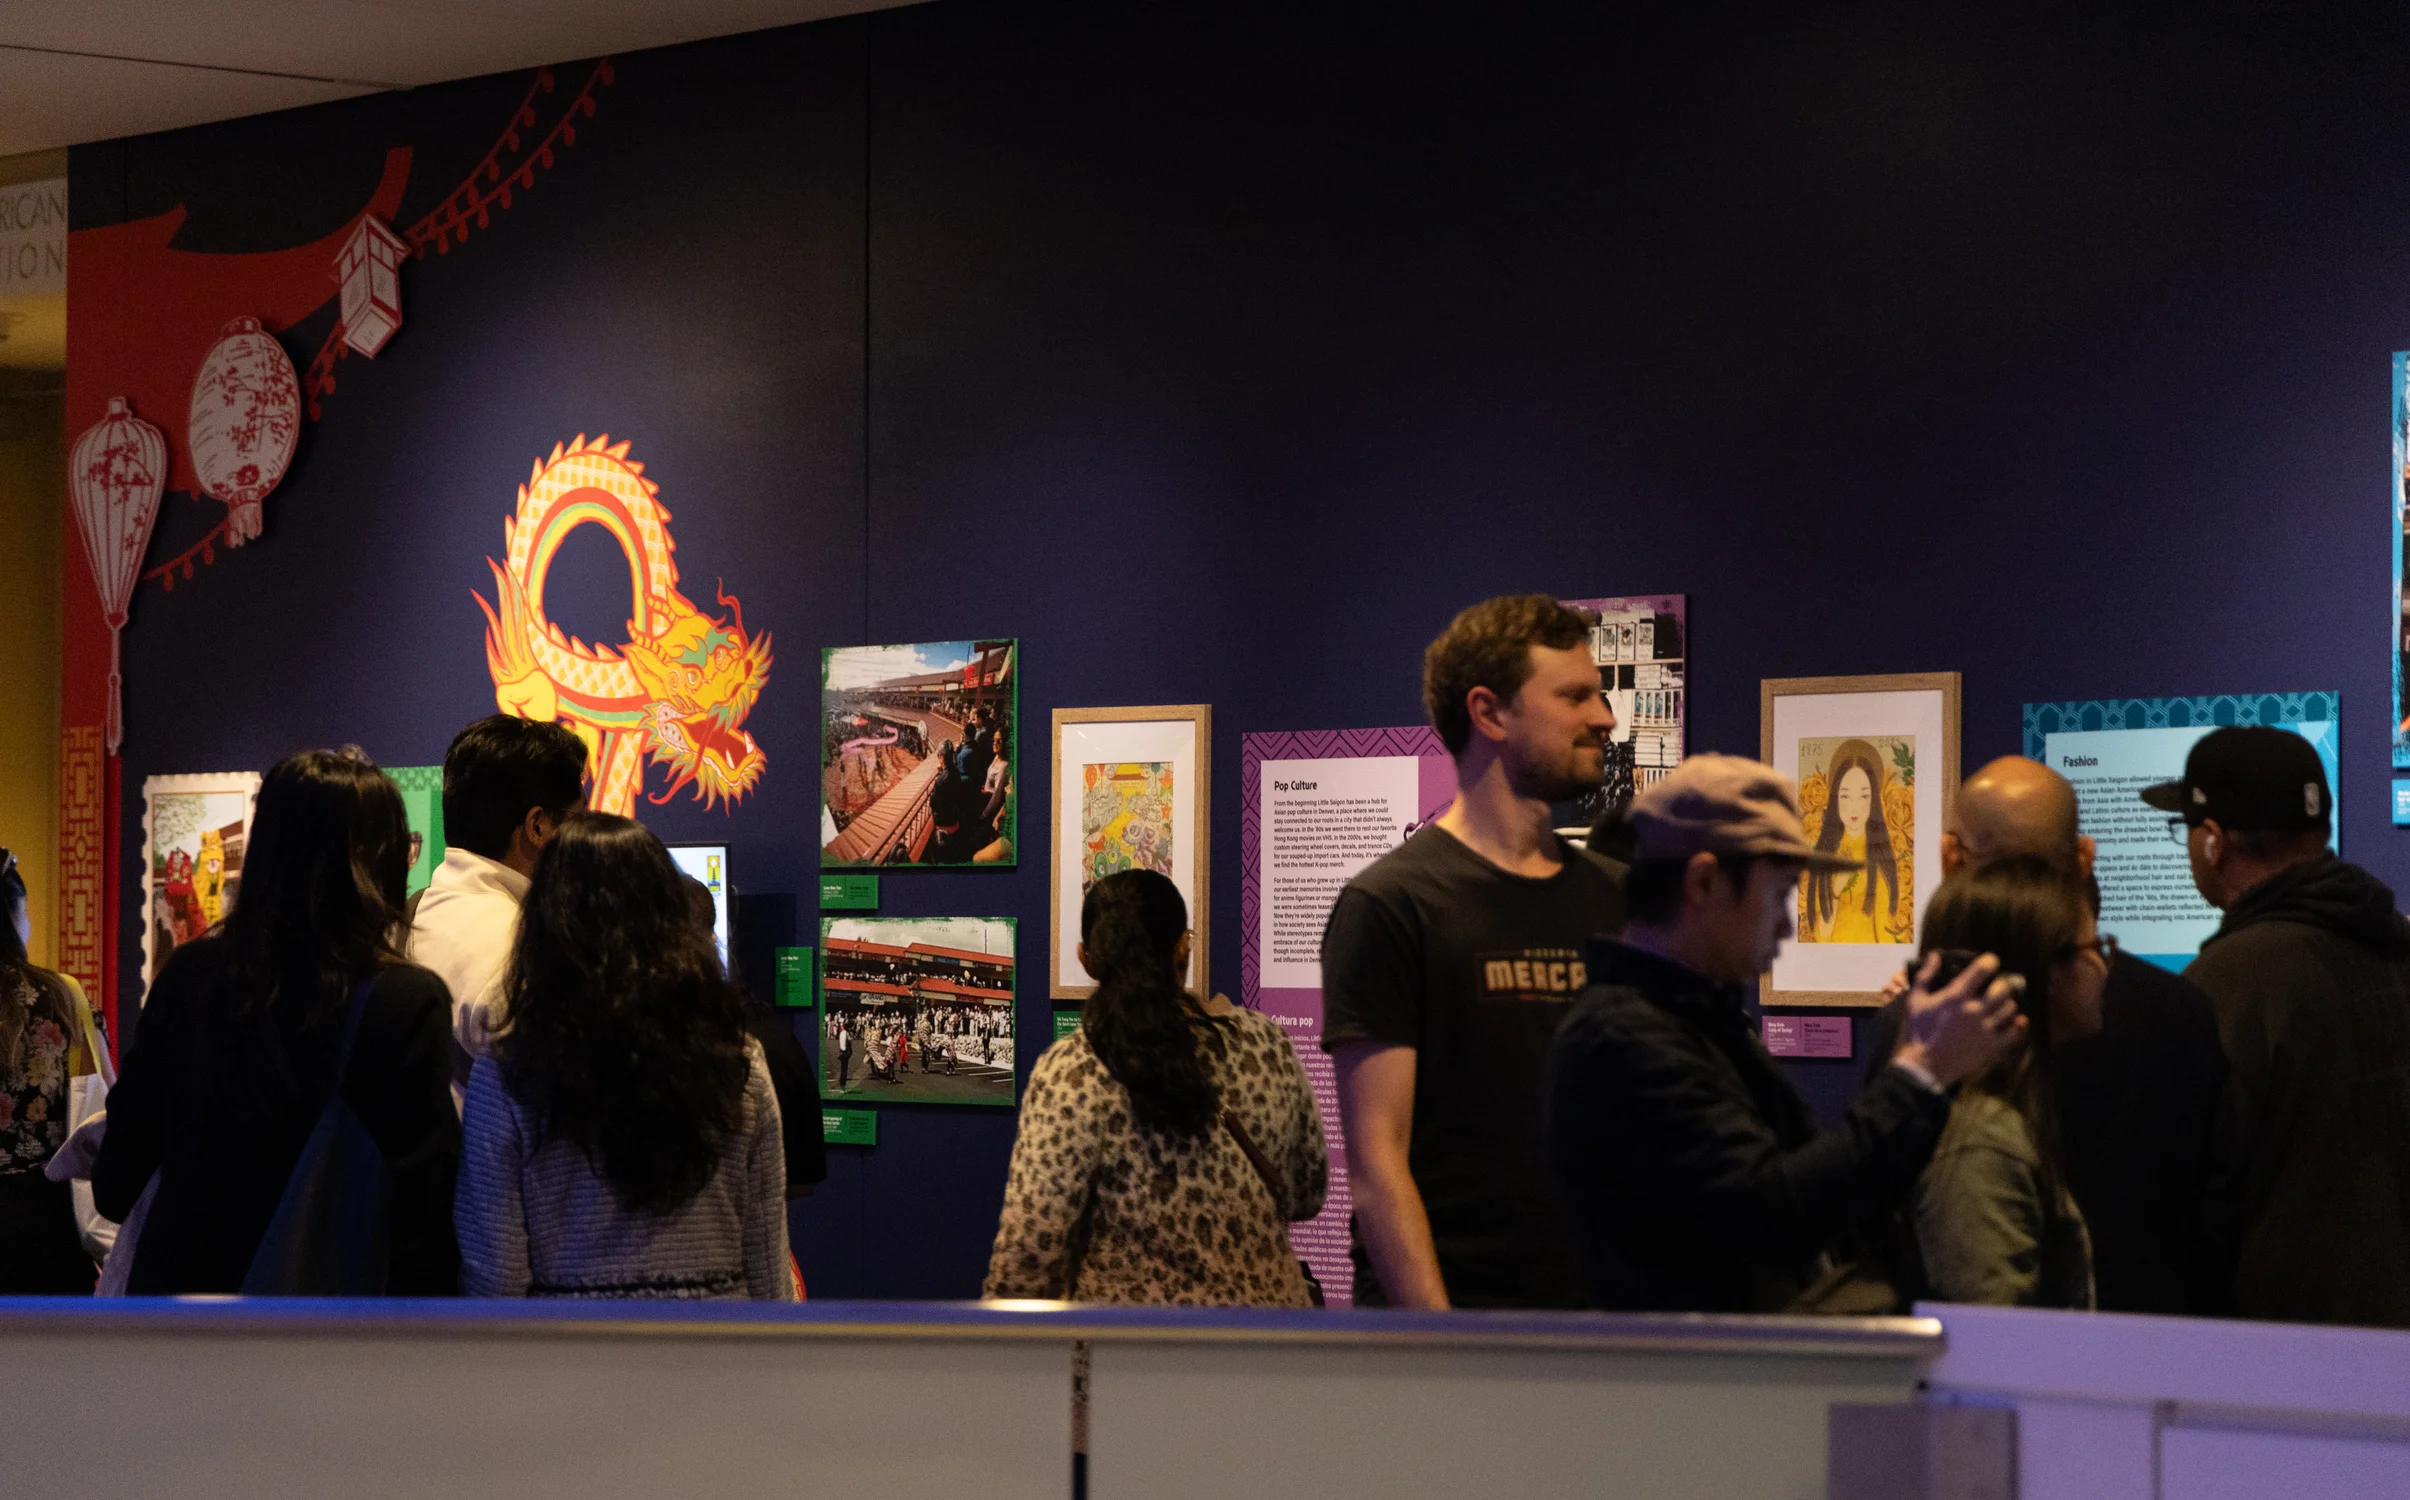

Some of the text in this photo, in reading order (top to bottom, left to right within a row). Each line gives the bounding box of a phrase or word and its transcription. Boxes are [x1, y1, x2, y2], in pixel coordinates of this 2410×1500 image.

[0, 240, 64, 281] ION
[2063, 756, 2098, 767] Fashion
[1274, 780, 1317, 792] Pop Culture
[1294, 799, 1317, 808] beginning
[1330, 798, 1345, 807] Saigon
[1318, 807, 1335, 816] Denver,
[1340, 807, 1352, 816] place
[1274, 817, 1283, 826] stay
[1344, 816, 1352, 824] city
[1377, 815, 1392, 824] always
[1274, 834, 1286, 843] Hong
[1287, 834, 1298, 843] Kong
[1371, 833, 1386, 842] bought
[1291, 843, 1309, 852] steering
[1289, 852, 1313, 860] souped-up
[1314, 852, 1329, 860] import
[1351, 852, 1364, 860] today,
[1315, 861, 1328, 869] K-pop
[1271, 1015, 1313, 1027] Cultura pop
